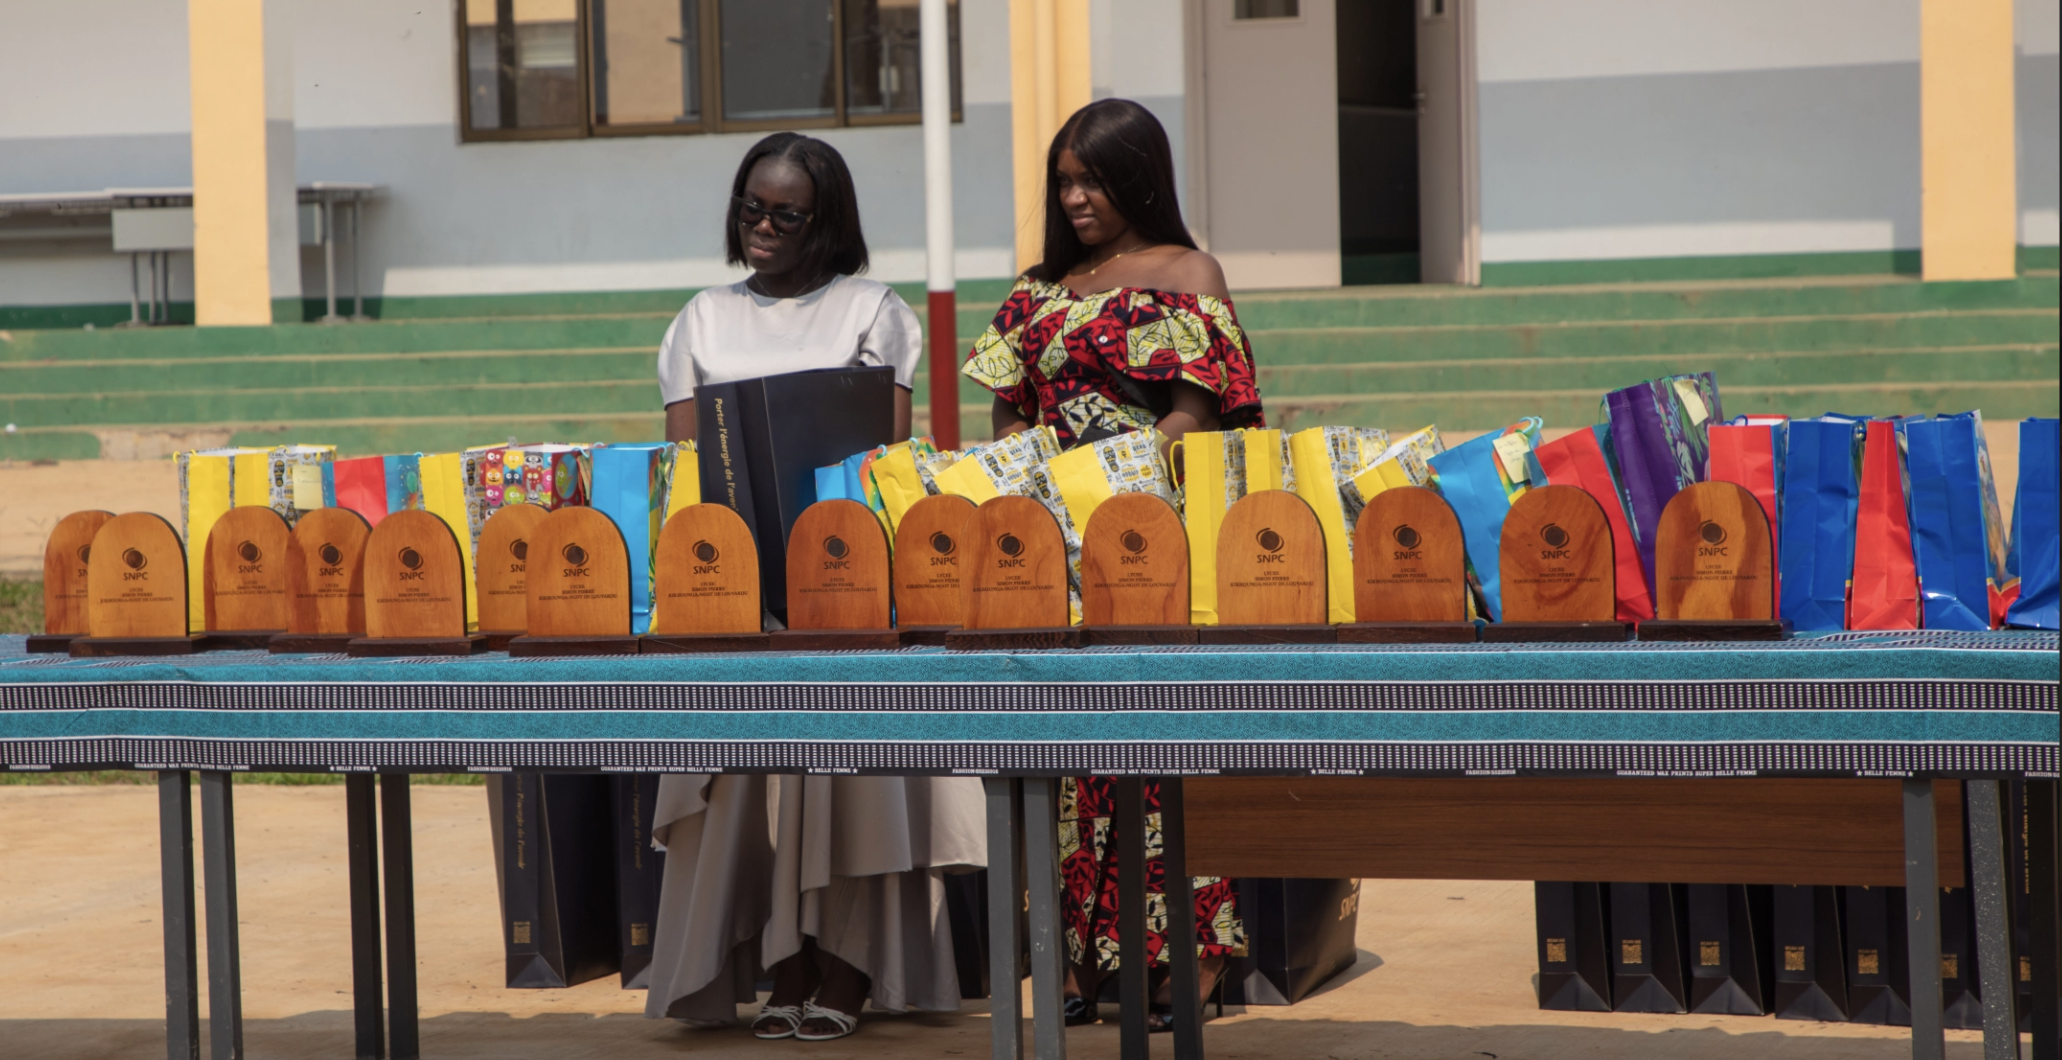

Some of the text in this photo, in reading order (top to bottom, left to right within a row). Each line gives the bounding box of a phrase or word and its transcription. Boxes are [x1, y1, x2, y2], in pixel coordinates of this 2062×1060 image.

[714, 398, 724, 426] Porter
[719, 427, 731, 466] l'énergie
[725, 469, 734, 480] de
[1394, 551, 1422, 560] SNPC
[1541, 550, 1570, 559] SNPC
[1698, 547, 1728, 556] SNPC
[930, 557, 956, 566] SNPC
[1120, 556, 1148, 565] SNPC
[1257, 554, 1284, 563] SNPC
[511, 564, 525, 572] SN
[824, 561, 850, 569] SNPC
[998, 559, 1025, 568] SNPC
[78, 569, 88, 577] SN
[238, 565, 262, 573] SNPC
[319, 568, 344, 576] SNPC
[563, 568, 589, 577] SNPC
[693, 565, 720, 574] SNPC
[123, 572, 148, 581] SNPC
[399, 572, 424, 580] SNPC
